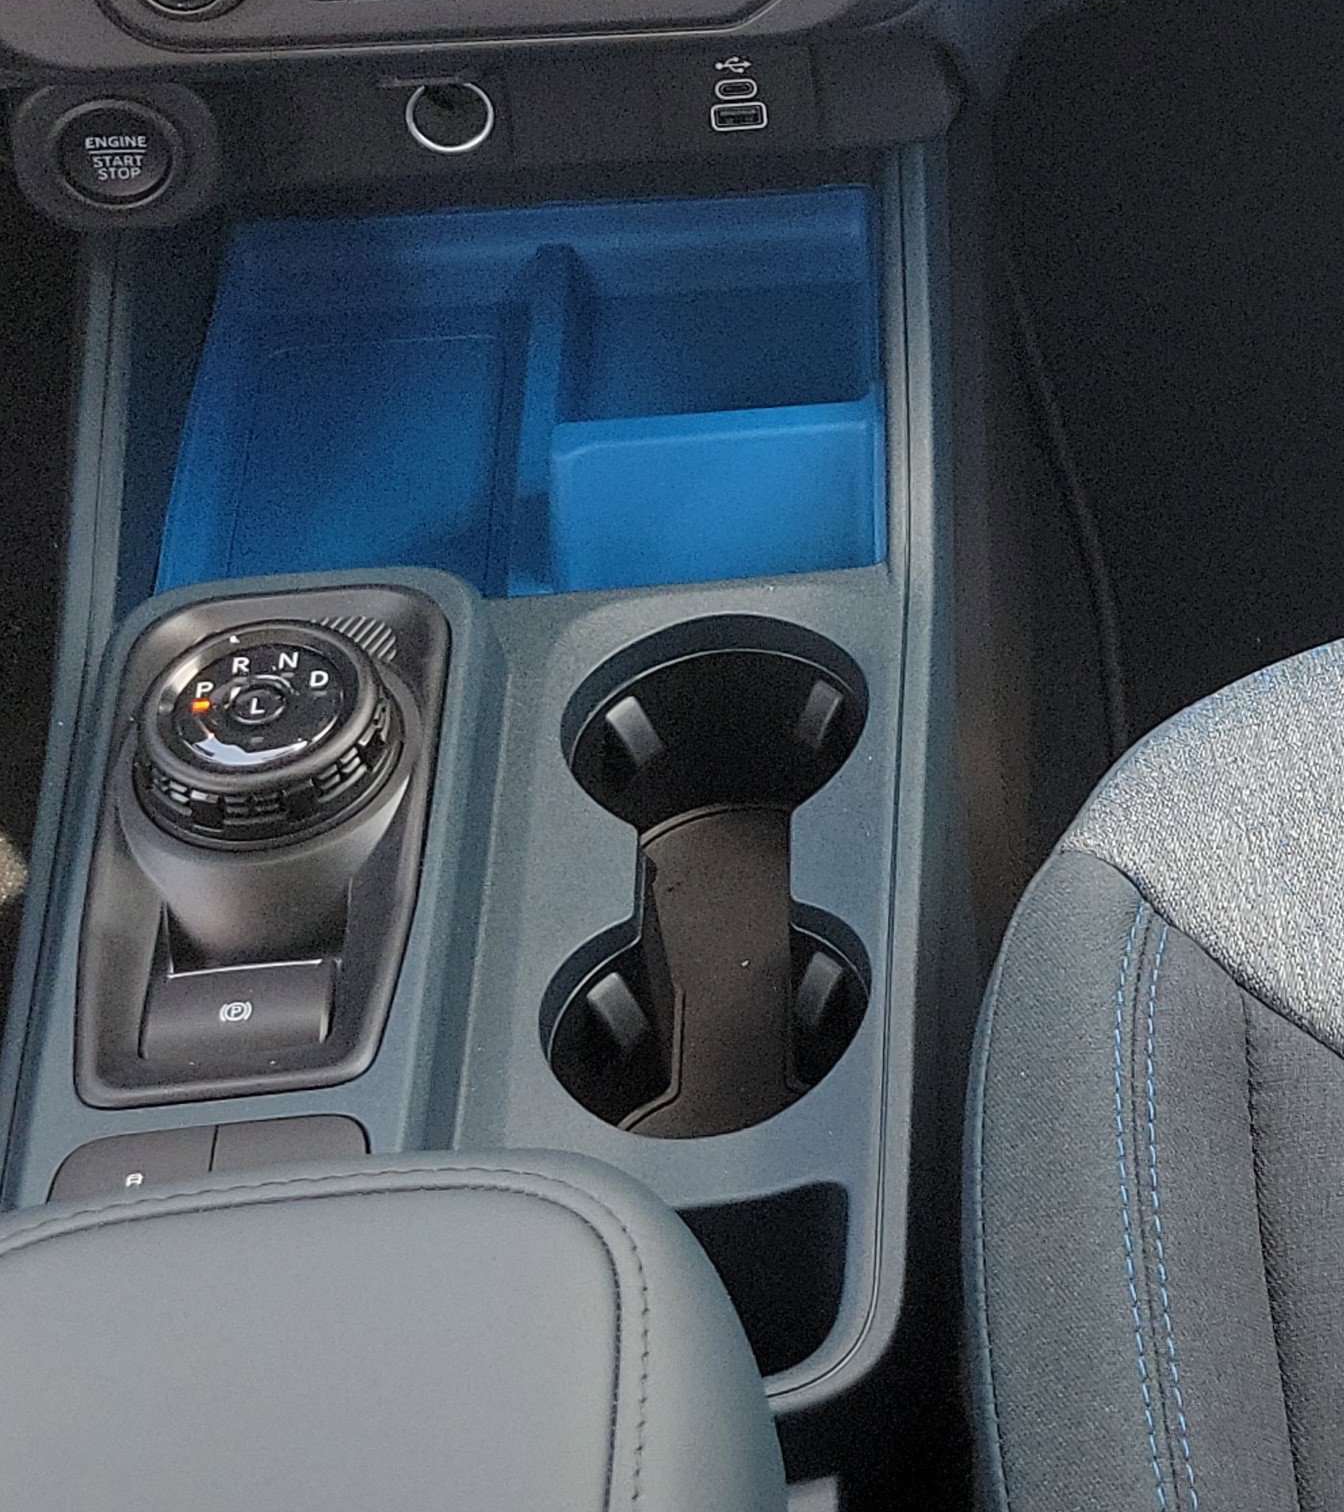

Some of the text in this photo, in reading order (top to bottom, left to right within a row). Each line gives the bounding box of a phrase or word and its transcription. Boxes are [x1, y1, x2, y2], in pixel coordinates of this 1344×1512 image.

[84, 136, 148, 150] ENGINE
[92, 154, 145, 169] START
[98, 167, 142, 182] STOP
[195, 651, 330, 699] P R N D
[250, 697, 266, 715] L
